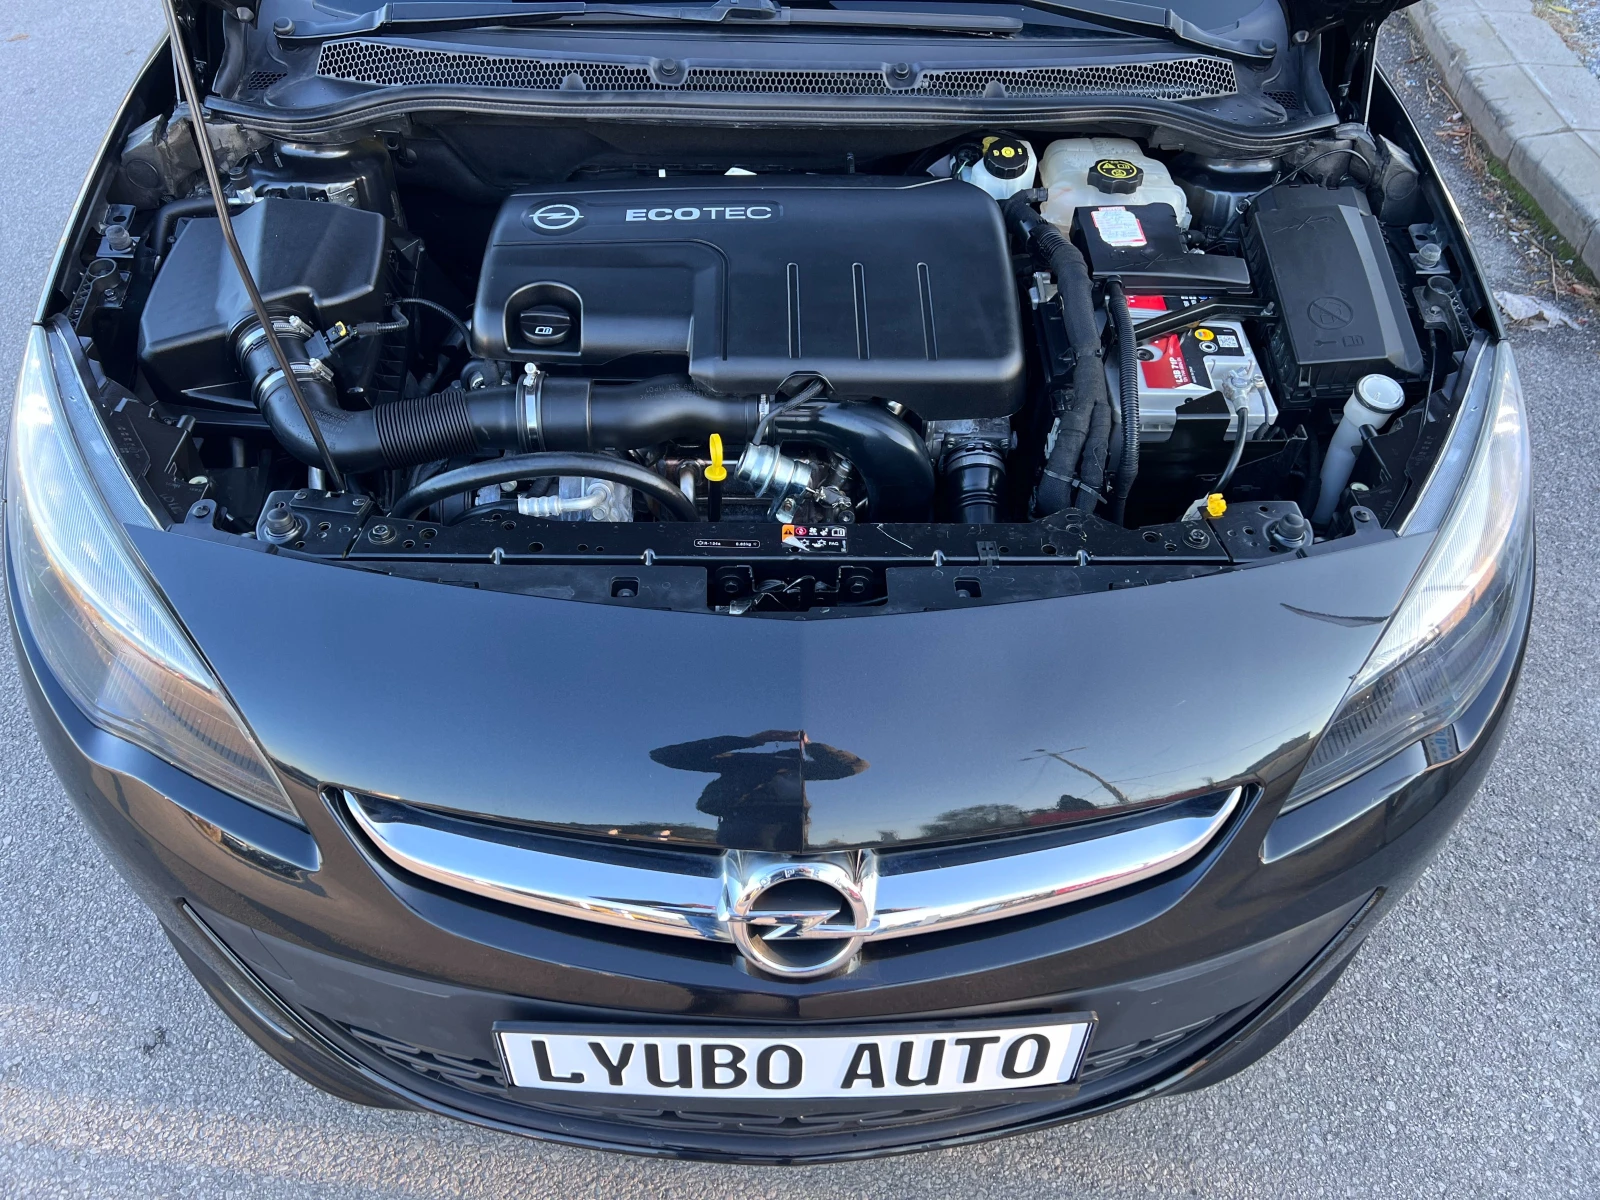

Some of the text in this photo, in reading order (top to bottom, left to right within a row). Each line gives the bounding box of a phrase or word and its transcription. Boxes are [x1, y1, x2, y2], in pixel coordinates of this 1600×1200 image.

[625, 206, 772, 222] ECOTEC
[530, 1033, 1051, 1091] LYUBO AUTO
